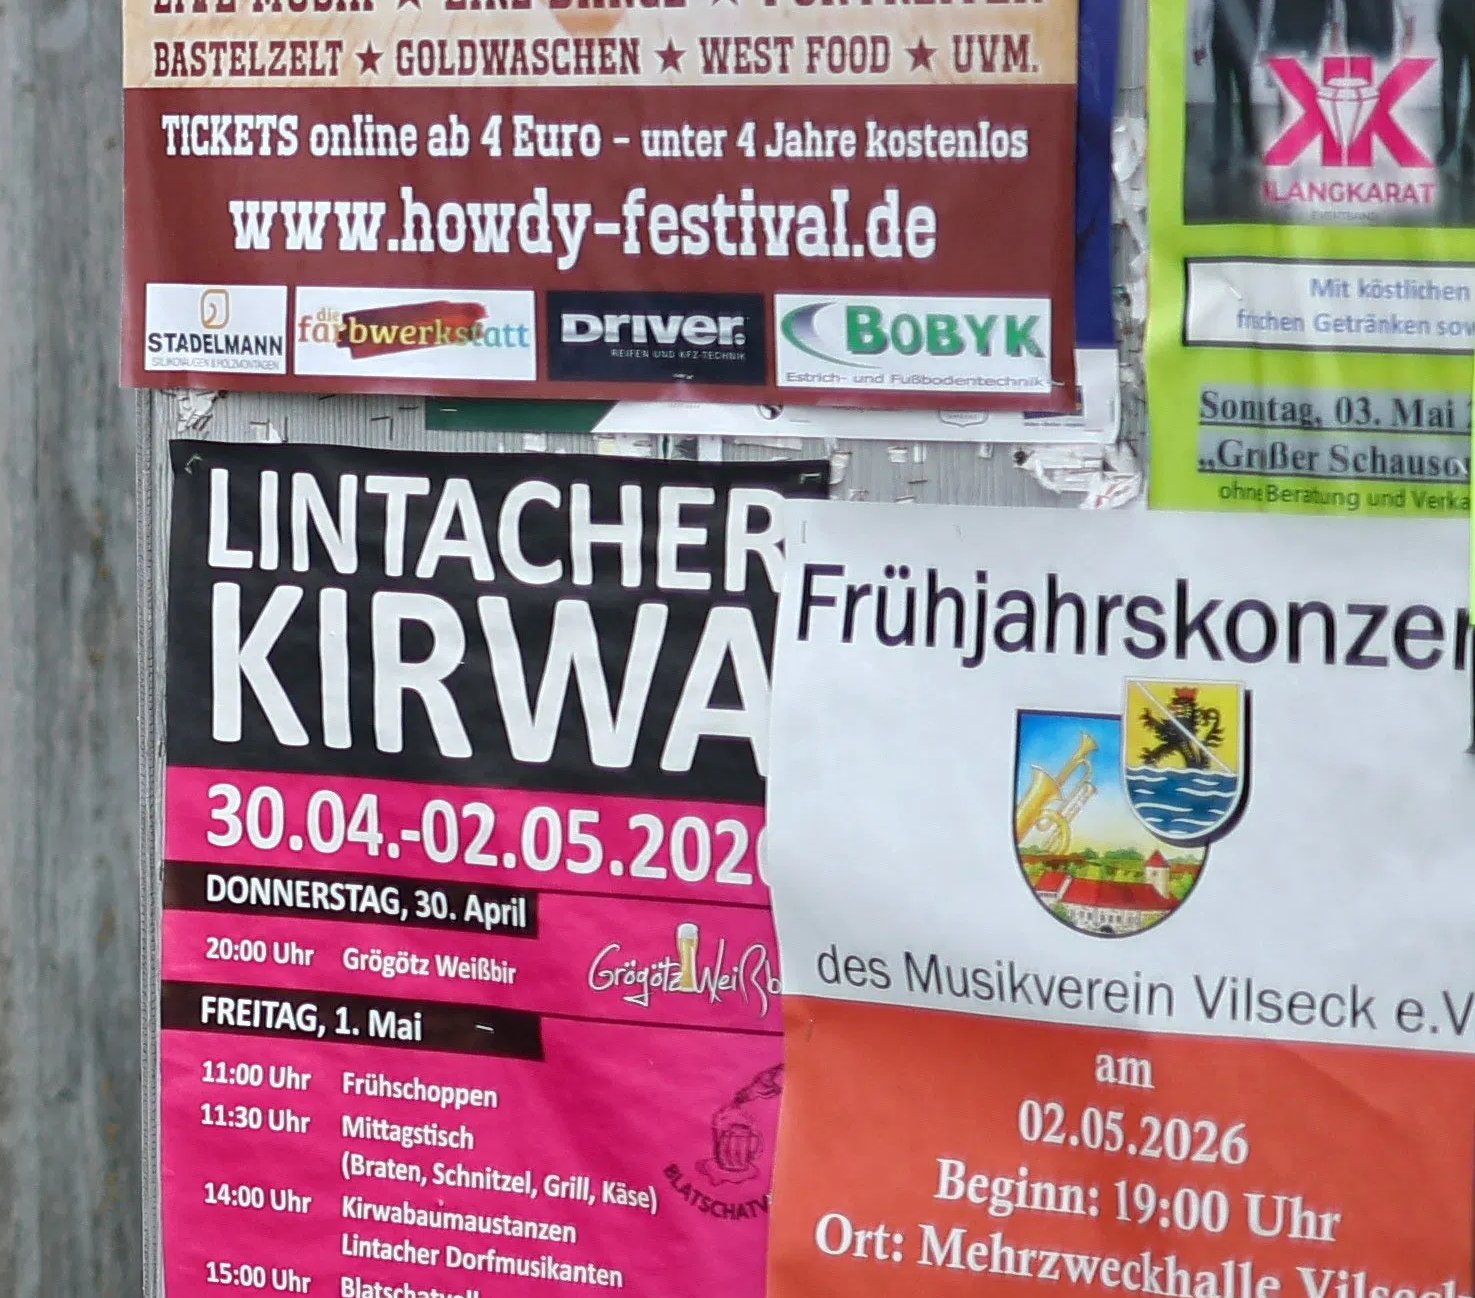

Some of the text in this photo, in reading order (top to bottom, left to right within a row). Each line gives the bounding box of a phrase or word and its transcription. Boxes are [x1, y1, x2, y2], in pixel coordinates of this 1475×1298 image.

[154, 34, 1040, 77] BASTELZELT GOLDWASCHEN WEST FOOD UVM.
[161, 114, 1028, 160] TICKETS online ab 4 Euro unter 4 Jahre kostenlos
[228, 186, 937, 271] www.howdy-festival.de
[1311, 278, 1470, 301] Mit köstlichen
[298, 314, 530, 350] farbwerkstatt
[316, 306, 340, 323] die
[845, 306, 1045, 359] BOBYK
[1314, 312, 1431, 335] Getränken
[148, 332, 282, 356] STADELMANN
[611, 350, 745, 361] REIFEN UND KFZ-TECHNIK
[786, 372, 1044, 388] Estrich- und Fußbodentechnik
[1336, 396, 1380, 426] 03.
[1391, 398, 1455, 429] Mai
[1267, 484, 1360, 511] Beratung
[1367, 488, 1406, 508] und
[207, 468, 785, 593] LINTACHER
[212, 581, 769, 777] KIRWA
[206, 874, 526, 930] DONNERSTAG, 30. April
[206, 937, 516, 985] 20:00 Uhr Grögötz Weißbir
[817, 944, 891, 990] des
[904, 951, 1174, 1018] Musikverein
[1193, 974, 1377, 1030] Vilseck
[201, 996, 423, 1042] FREITAG, 1. Mai
[201, 1060, 498, 1110] 11:00 Uhr Frühschoppen
[1095, 1053, 1155, 1089] am
[200, 1103, 475, 1150] 11:30 Uhr Mittagstisch
[1019, 1100, 1250, 1165] 02.05.2026
[341, 1151, 658, 1215] (Braten, Schnitzel, Grill, Käse)
[934, 1158, 1342, 1242] Beginn: 19:00 Uhr
[204, 1182, 577, 1245] 14:00 Uhr Kirwabaumaustanzen
[341, 1233, 623, 1289] Lintacher Dorfmusikanten
[815, 1213, 904, 1262] Ort:
[206, 1261, 266, 1288] 15:00
[271, 1267, 311, 1294] Uhr
